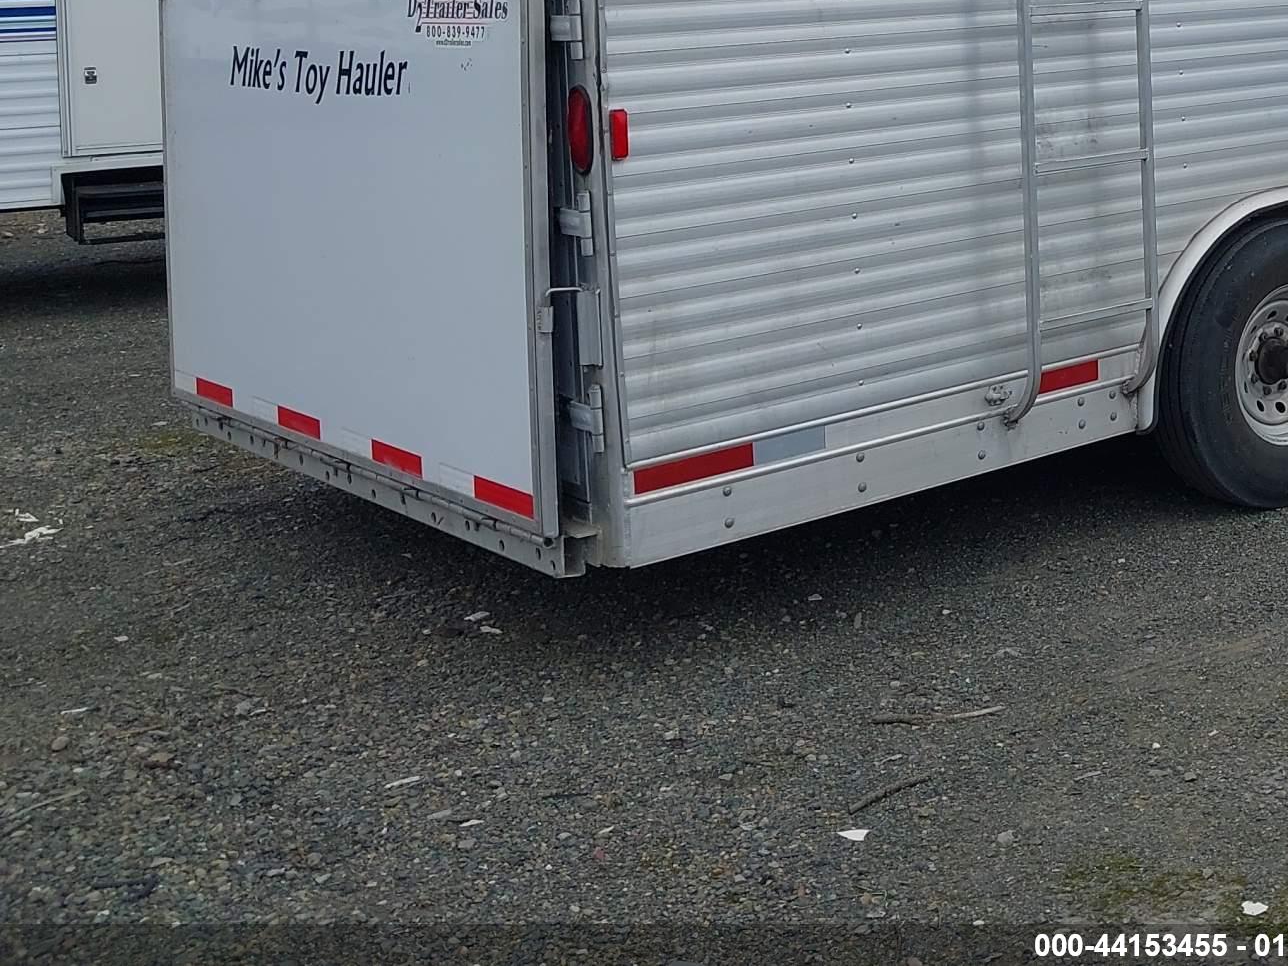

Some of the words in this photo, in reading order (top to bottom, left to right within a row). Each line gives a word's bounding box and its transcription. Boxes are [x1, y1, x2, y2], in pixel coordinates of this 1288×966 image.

[426, 25, 485, 39] 800-839-9477
[230, 45, 287, 91] Mike's
[294, 50, 331, 105] Toy
[335, 50, 408, 96] Hauler
